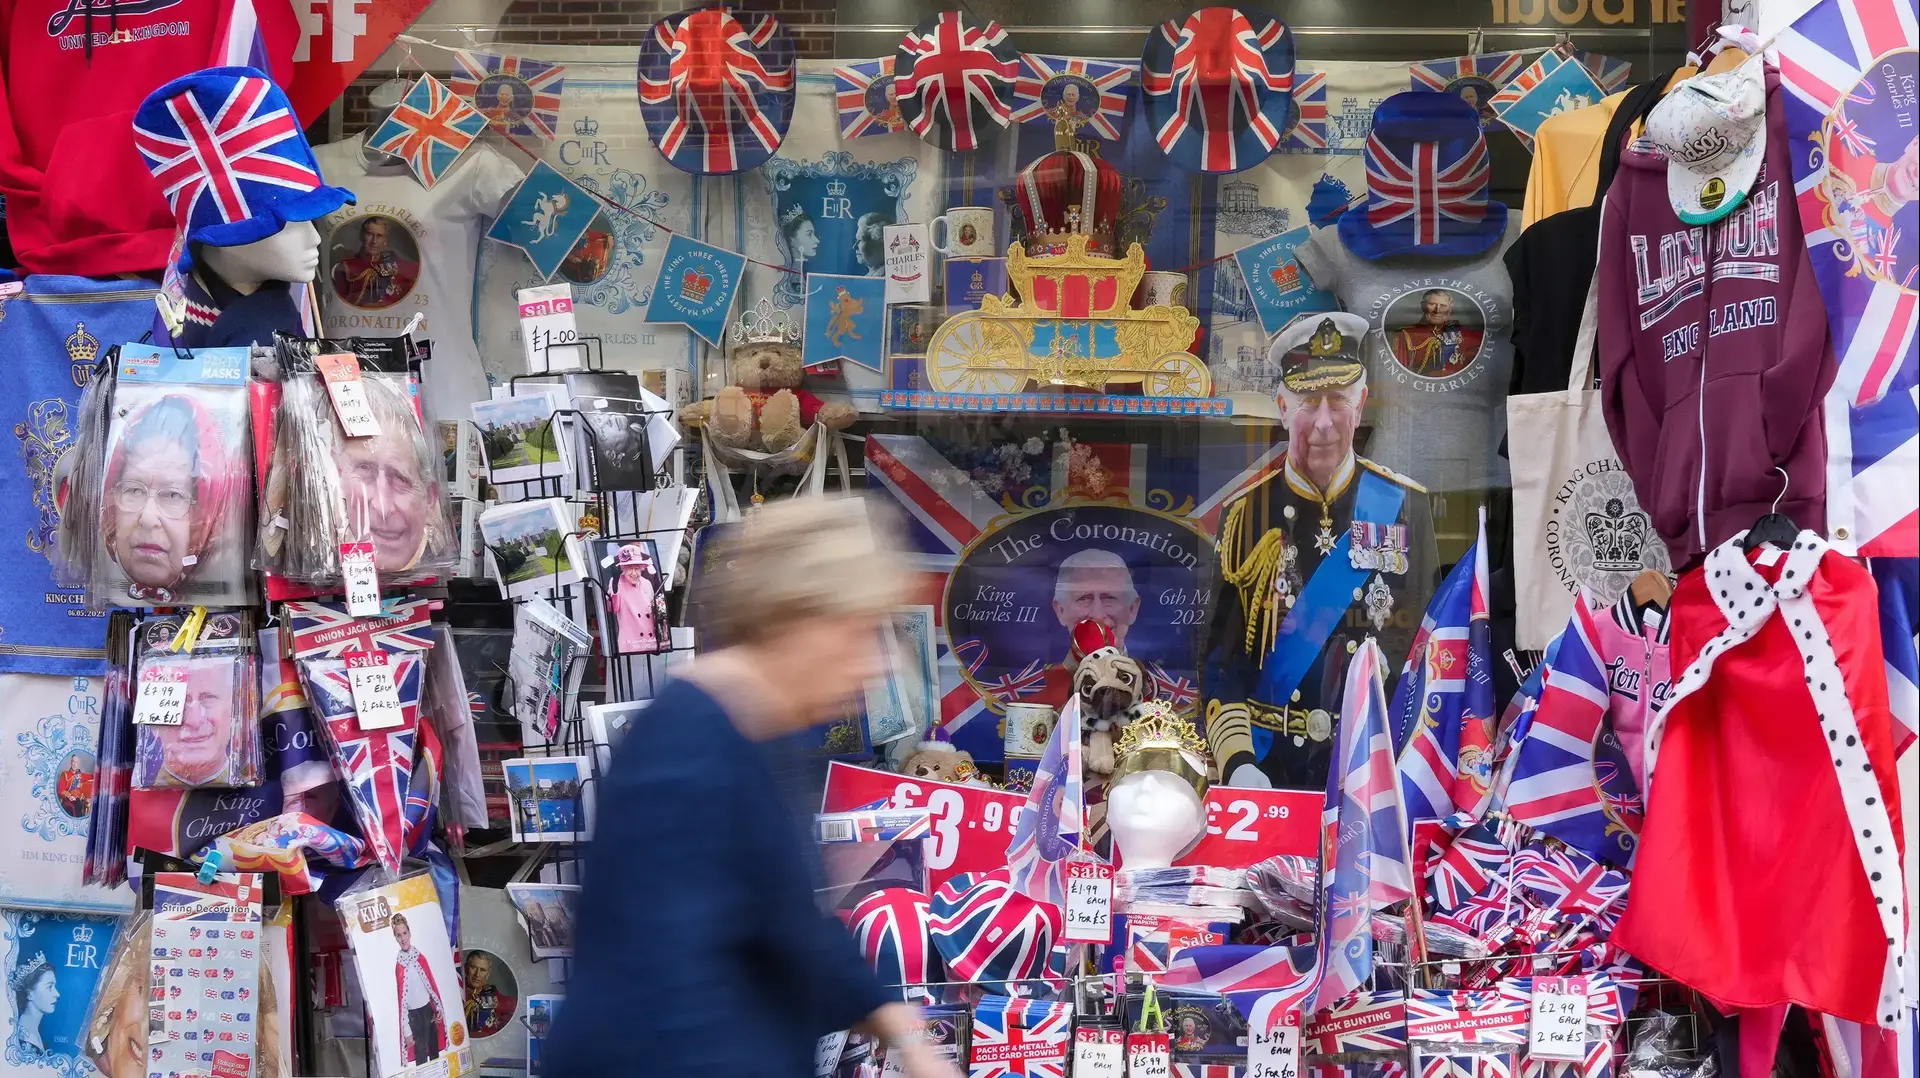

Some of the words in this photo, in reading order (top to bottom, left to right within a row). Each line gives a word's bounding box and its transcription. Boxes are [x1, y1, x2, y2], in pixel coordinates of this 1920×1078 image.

[59, 32, 109, 50] UNIED
[132, 21, 190, 41] KINGDOM
[1881, 63, 1903, 110] Charles
[1898, 73, 1917, 106] King
[364, 204, 428, 238] CHARLES
[1630, 181, 1779, 305] LONDON
[688, 251, 714, 260] THREE
[886, 253, 926, 266] CHARLES
[1258, 243, 1282, 260] THREE
[668, 255, 684, 273] KING
[714, 260, 729, 289] CHEERS
[1252, 263, 1260, 283] KING
[414, 294, 429, 306] 23
[715, 291, 727, 307] FOR
[1255, 285, 1268, 300] THE
[1369, 293, 1391, 319] GOD
[1393, 279, 1433, 294] SAVE
[1439, 278, 1474, 292] THE
[1474, 290, 1500, 323] KING
[524, 300, 567, 317] sale
[666, 294, 699, 316] MAJESTY
[1270, 295, 1306, 308] MAJESTY
[702, 305, 714, 315] HIS
[1663, 296, 1779, 363] ENGLAND
[642, 334, 656, 345] III
[203, 356, 243, 367] PARTY
[201, 368, 241, 379] MASKS
[330, 364, 352, 380] Sale
[1378, 348, 1408, 384] KING
[1412, 362, 1485, 393] CHARLES
[340, 399, 360, 408] PARTY
[1556, 469, 1584, 504] KING
[1586, 459, 1625, 476] CHA
[989, 533, 1044, 565] The
[1050, 518, 1199, 571] Coronation
[343, 550, 373, 562] sale
[45, 593, 66, 603] KING
[975, 585, 1016, 607] King
[1159, 588, 1186, 605] 6th
[67, 610, 106, 618] 06.05.2023
[953, 603, 1012, 622] Charles
[1015, 607, 1040, 623] III
[1171, 609, 1205, 625] 202
[314, 629, 345, 644] UNION
[346, 623, 369, 636] JACK
[349, 652, 384, 667] sale
[362, 700, 368, 713] 2
[212, 793, 265, 818] King
[42, 852, 68, 864] KING
[1071, 864, 1110, 879] sale
[1071, 880, 1098, 895] £1.99
[162, 904, 192, 914] String
[196, 904, 250, 913] Decoration
[1087, 897, 1107, 906] EACH
[360, 902, 389, 924] KING
[1068, 909, 1075, 922] 3
[1078, 913, 1091, 923] FOR
[1093, 910, 1107, 925] £5
[1180, 933, 1214, 949] Sale
[1537, 978, 1582, 996] sale
[1314, 1020, 1341, 1035] JACK
[1343, 1011, 1391, 1029] BUNTING
[1418, 1022, 1451, 1034] UNION
[1453, 1019, 1478, 1030] JACK
[1480, 1015, 1513, 1026] HORNS
[1558, 1015, 1581, 1025] EACH
[1077, 1030, 1121, 1044] sale
[1537, 1032, 1545, 1043] 2
[1550, 1032, 1564, 1042] FOR
[1566, 1029, 1583, 1043] £5
[976, 1046, 998, 1054] PACK
[976, 1054, 998, 1062] GOLD
[999, 1052, 1022, 1060] CARD
[1023, 1049, 1060, 1058] CROWNS
[1130, 1041, 1166, 1054] sale
[1133, 1054, 1161, 1068] £5.99
[1146, 1067, 1166, 1076] EACH
[1254, 1063, 1262, 1078] 3
[1265, 1068, 1279, 1078] FOR
[1281, 1064, 1295, 1078] £10
